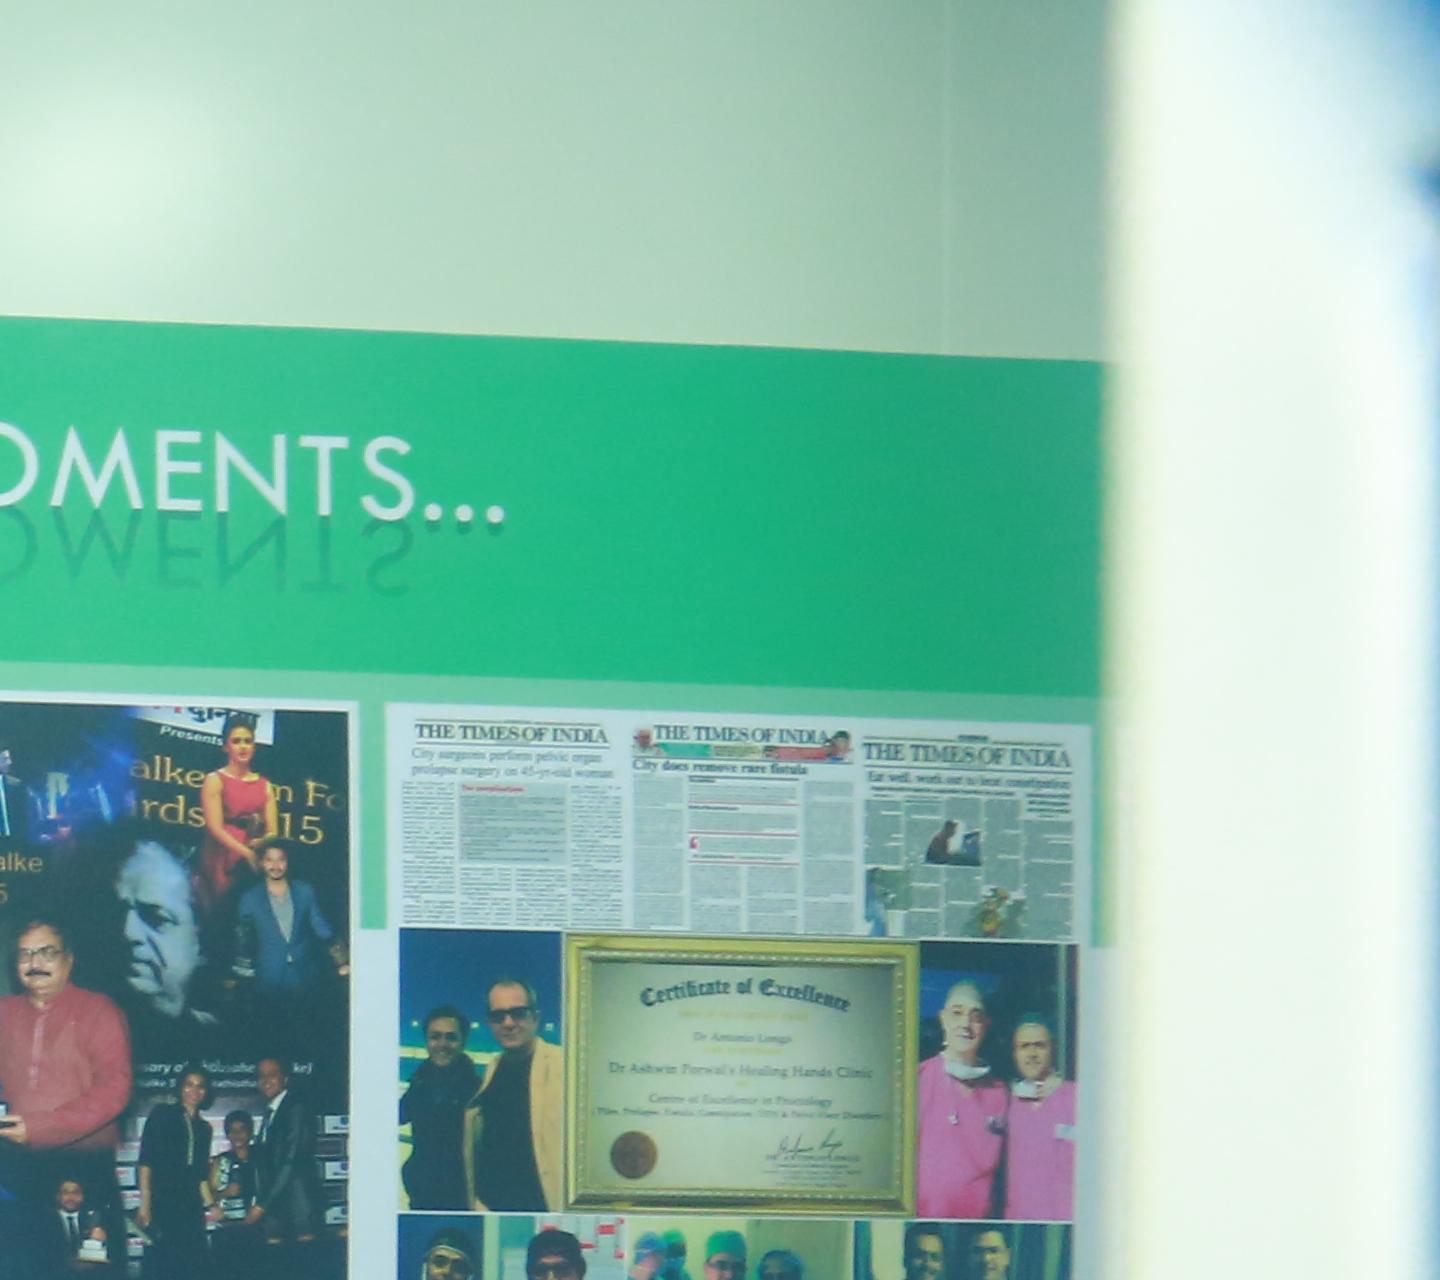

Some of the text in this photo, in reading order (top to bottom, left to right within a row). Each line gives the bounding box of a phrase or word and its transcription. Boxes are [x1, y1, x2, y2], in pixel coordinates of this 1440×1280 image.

[414, 724, 609, 743] THE TIMES OF INDIA
[654, 725, 829, 744] THE TIMES OF INDIA
[863, 742, 1070, 767] THE TIMES OF INDIA
[640, 978, 851, 1013] Certificate of Excellence
